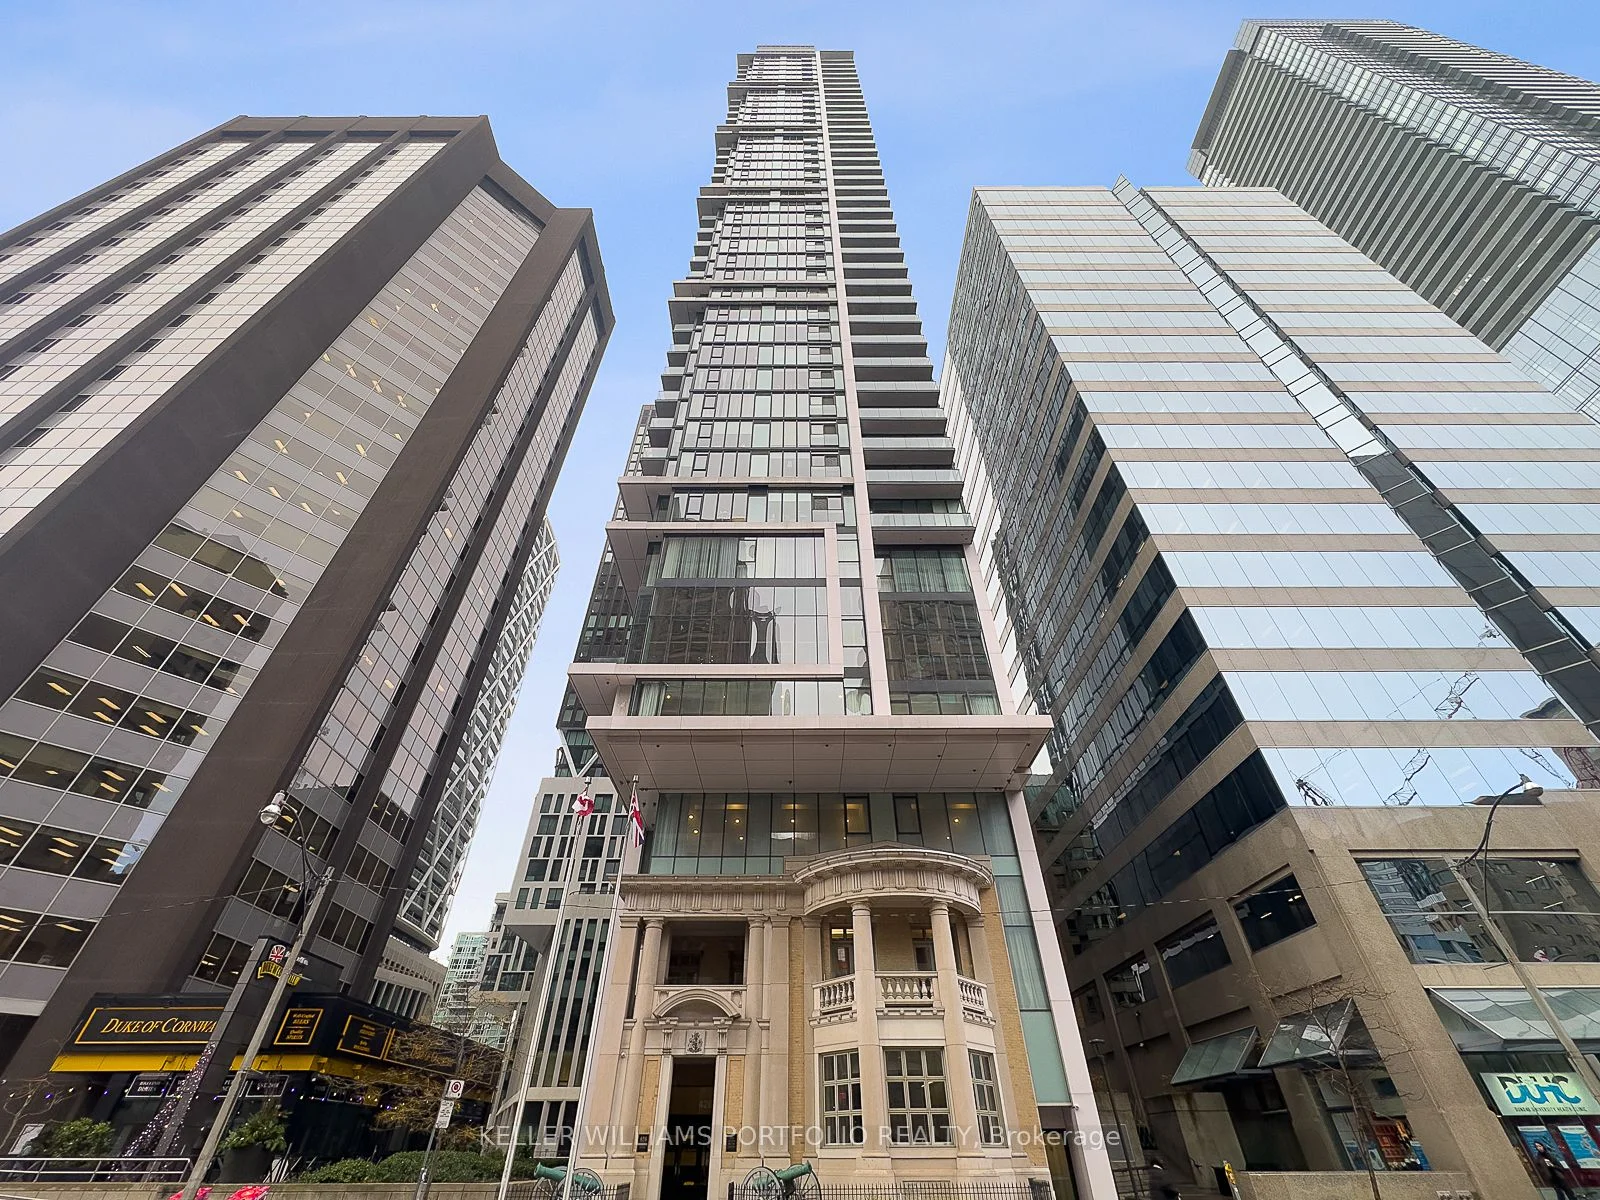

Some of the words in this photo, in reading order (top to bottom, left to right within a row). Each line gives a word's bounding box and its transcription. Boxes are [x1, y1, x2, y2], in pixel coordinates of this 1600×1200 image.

[100, 1018, 142, 1033] DUKE
[141, 1020, 163, 1033] OF
[161, 1017, 218, 1033] CORNWA
[1497, 1076, 1581, 1104] DUHC
